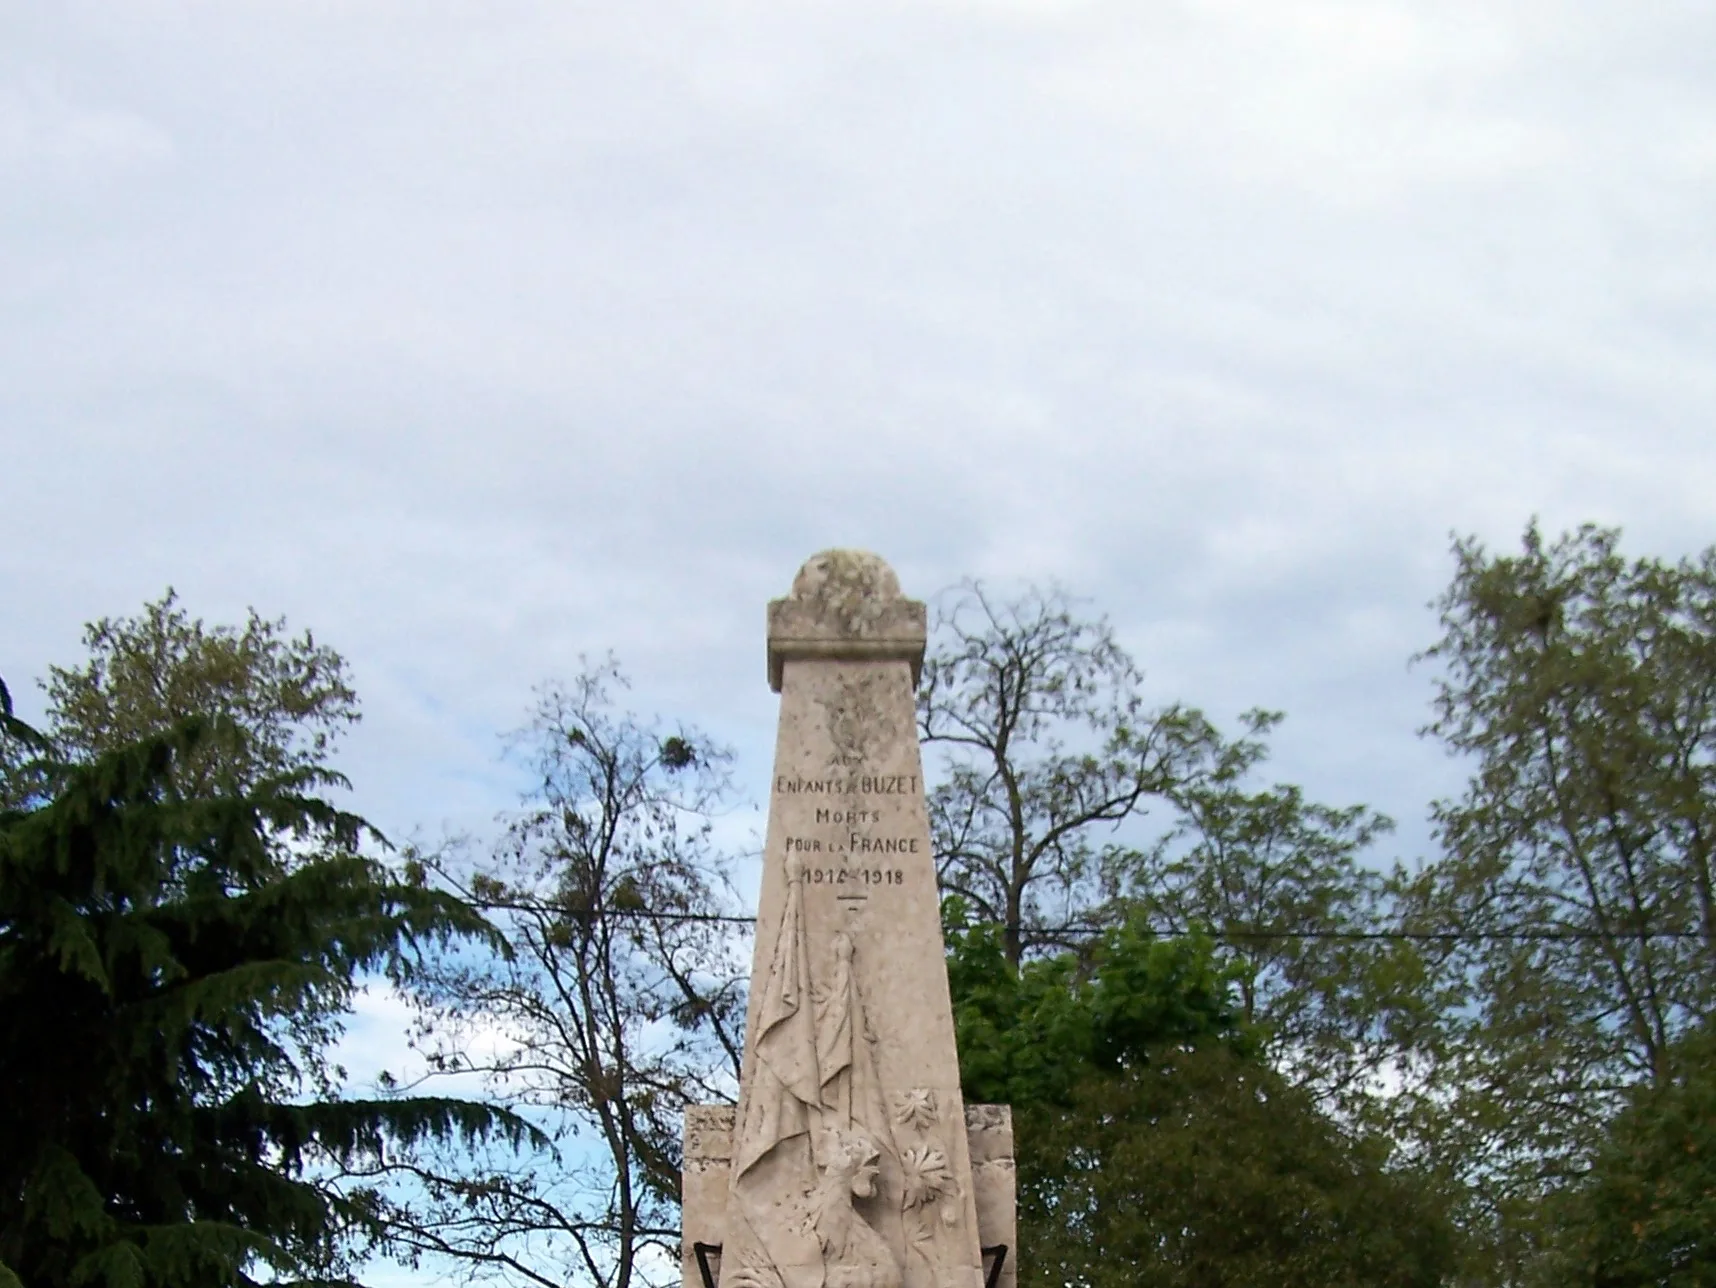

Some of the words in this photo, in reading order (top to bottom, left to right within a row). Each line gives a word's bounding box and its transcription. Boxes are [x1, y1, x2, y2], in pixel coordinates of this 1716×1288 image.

[862, 776, 918, 794] BUZET
[816, 809, 880, 824] MORTS
[786, 837, 821, 852] POUR
[850, 833, 918, 853] FRANCE
